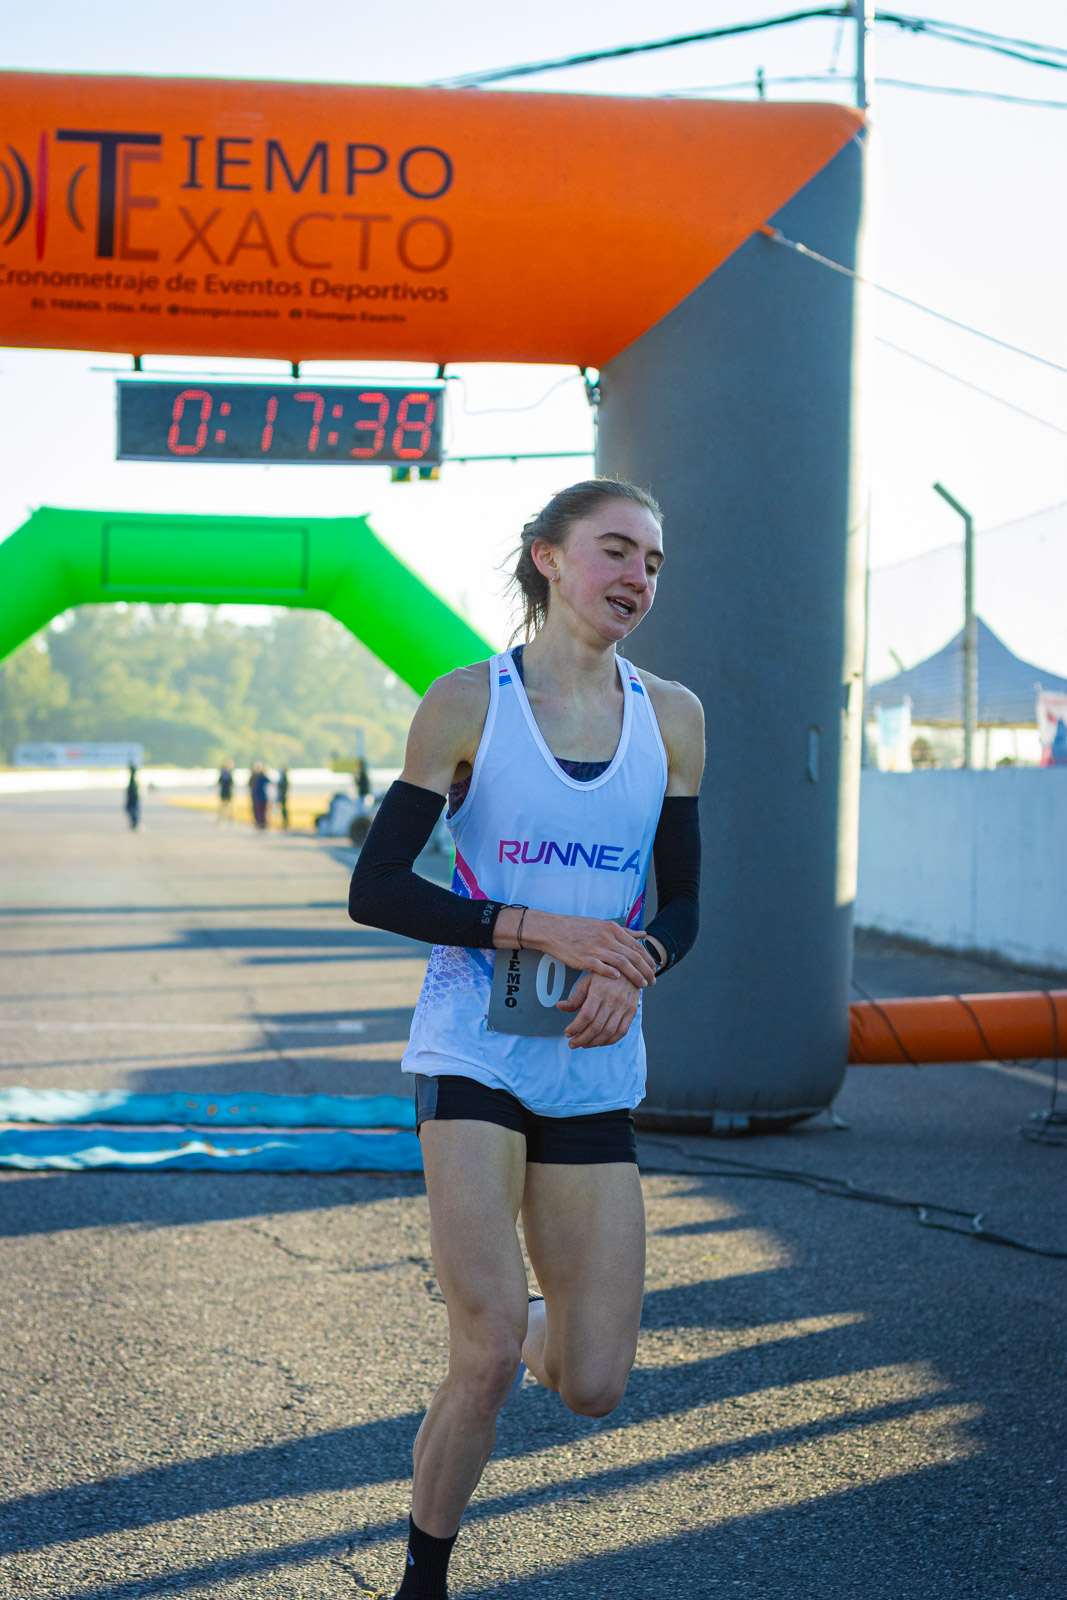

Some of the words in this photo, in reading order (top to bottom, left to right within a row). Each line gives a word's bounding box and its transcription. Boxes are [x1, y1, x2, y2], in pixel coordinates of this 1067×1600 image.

[166, 272, 198, 293] de
[204, 273, 303, 298] Eventos
[310, 277, 450, 303] Deportivos
[167, 389, 437, 459] 0:17:38
[498, 839, 641, 875] RUNNEA
[504, 949, 521, 1009] IEMPO
